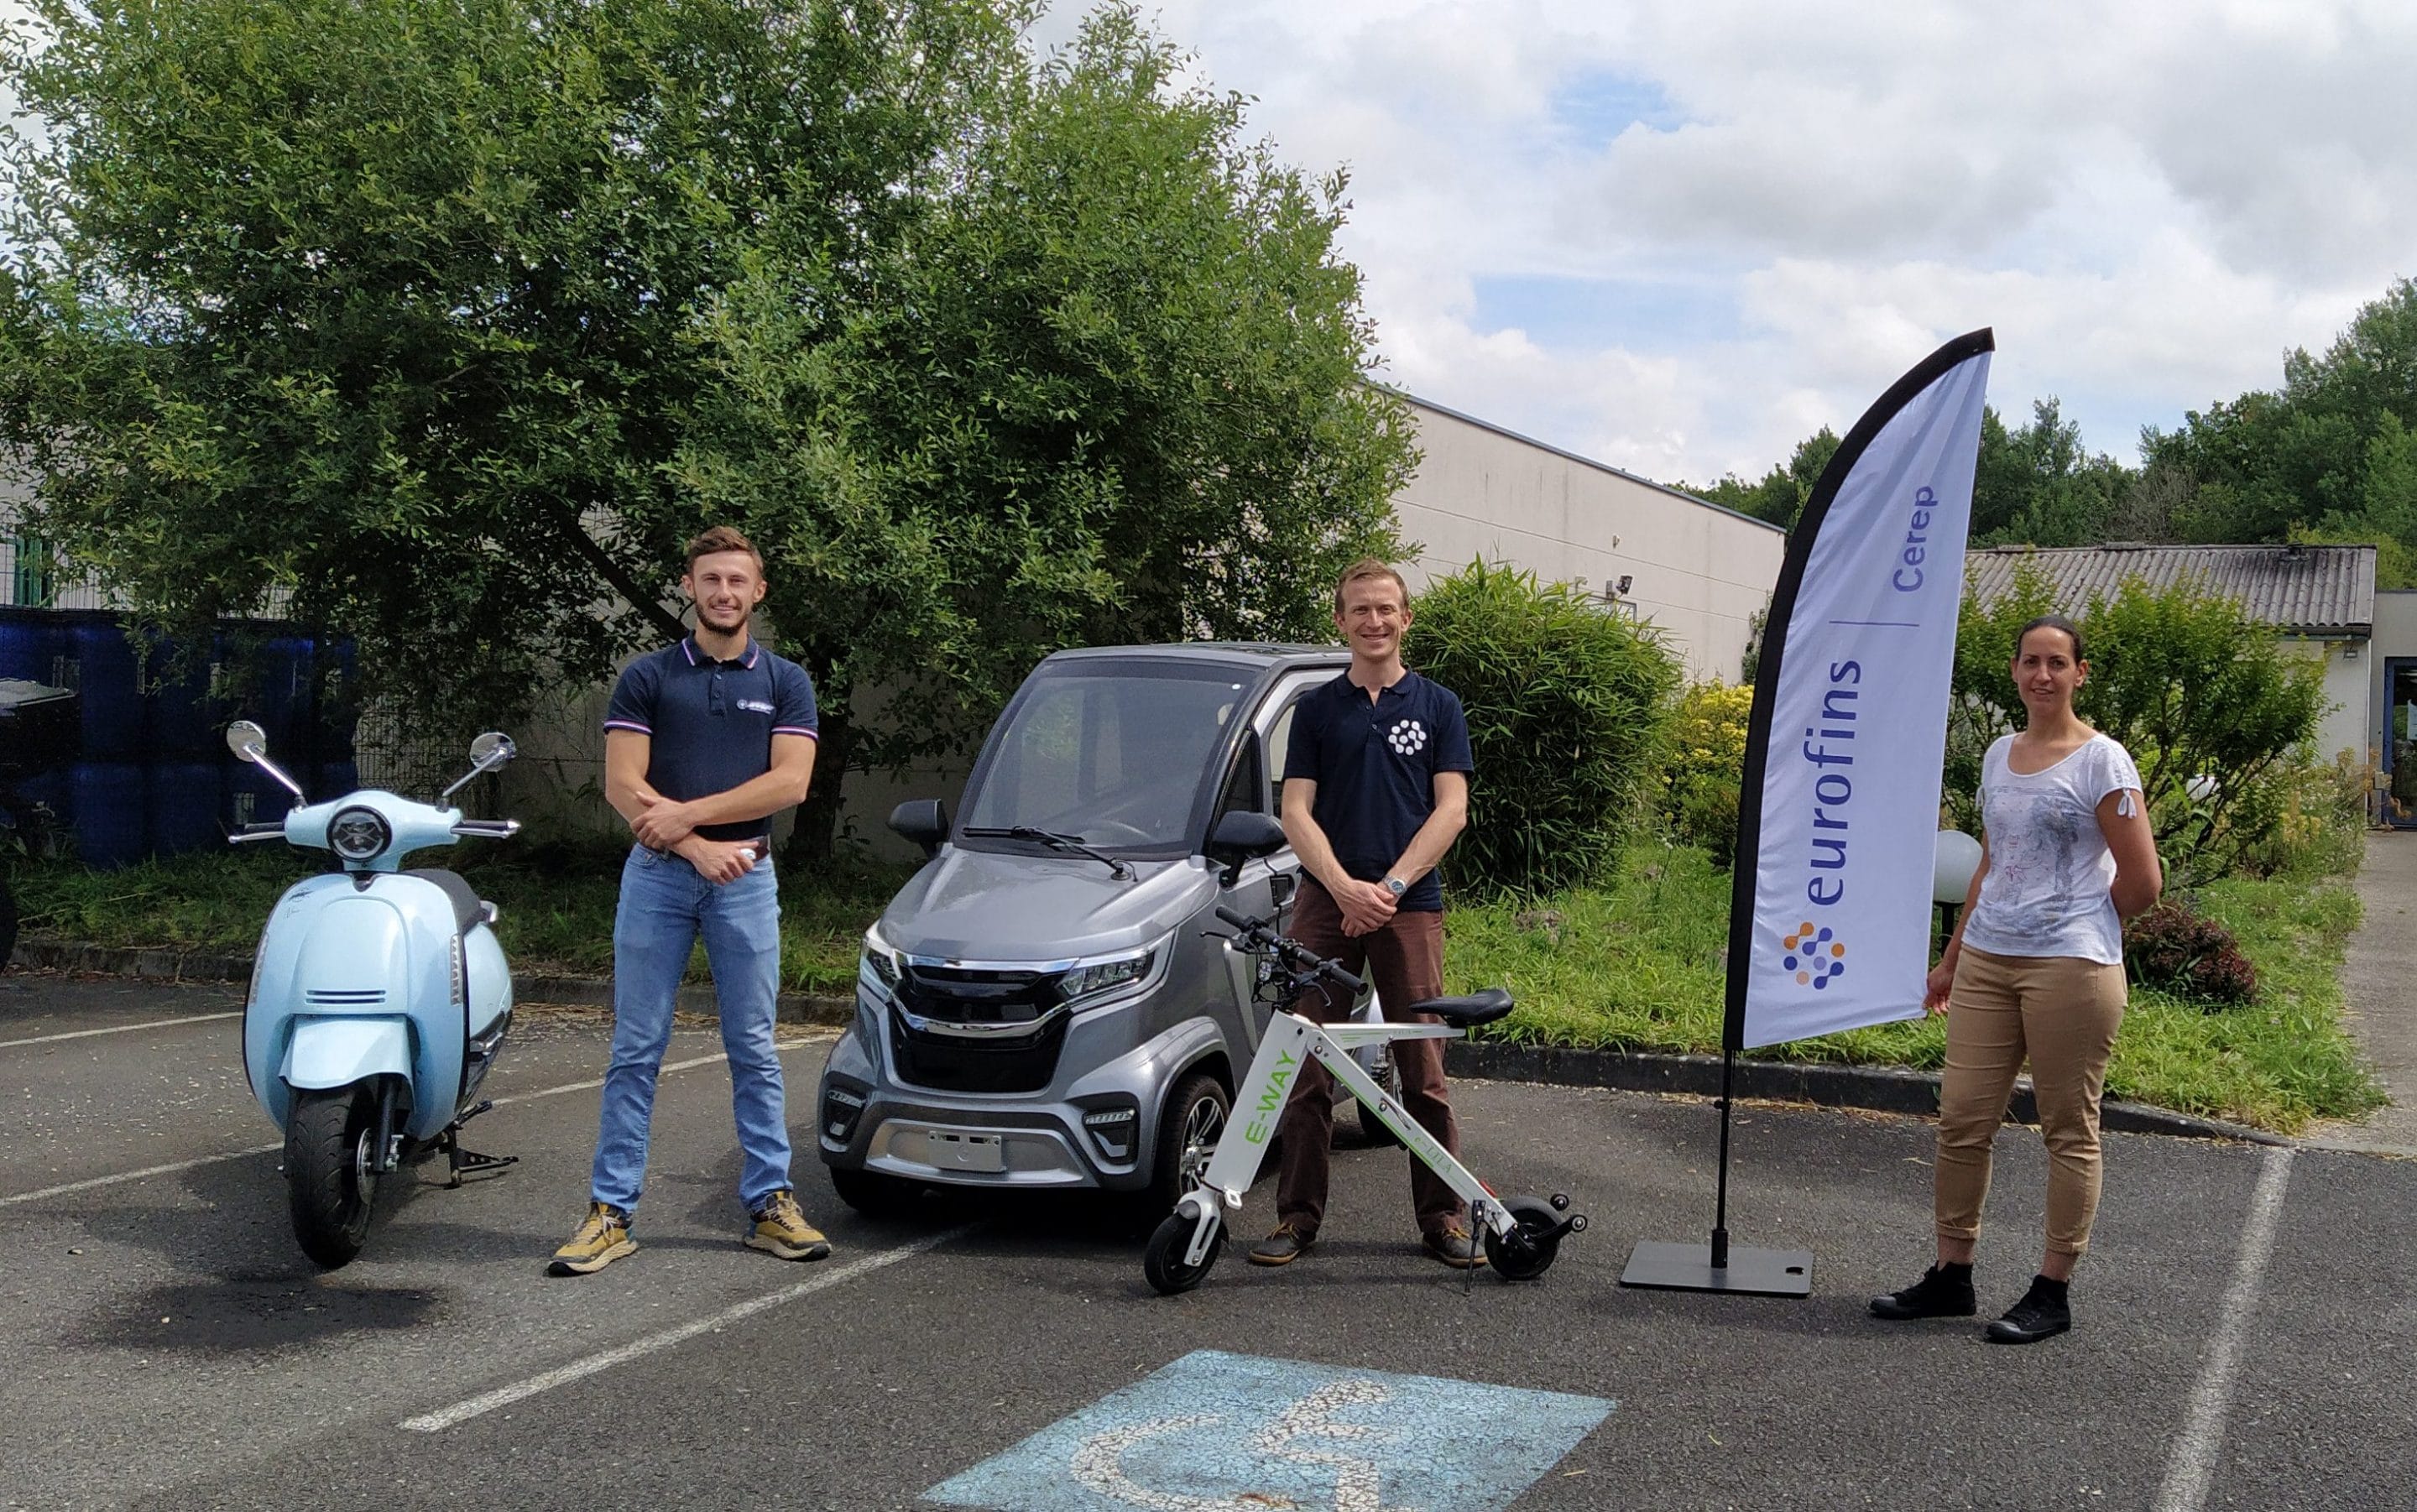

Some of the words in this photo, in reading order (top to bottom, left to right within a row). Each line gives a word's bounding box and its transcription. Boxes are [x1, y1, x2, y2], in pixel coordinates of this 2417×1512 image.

[1892, 485, 1939, 594] Cerep
[1803, 659, 1862, 906] eurofins
[1245, 1049, 1296, 1144] E-WAY
